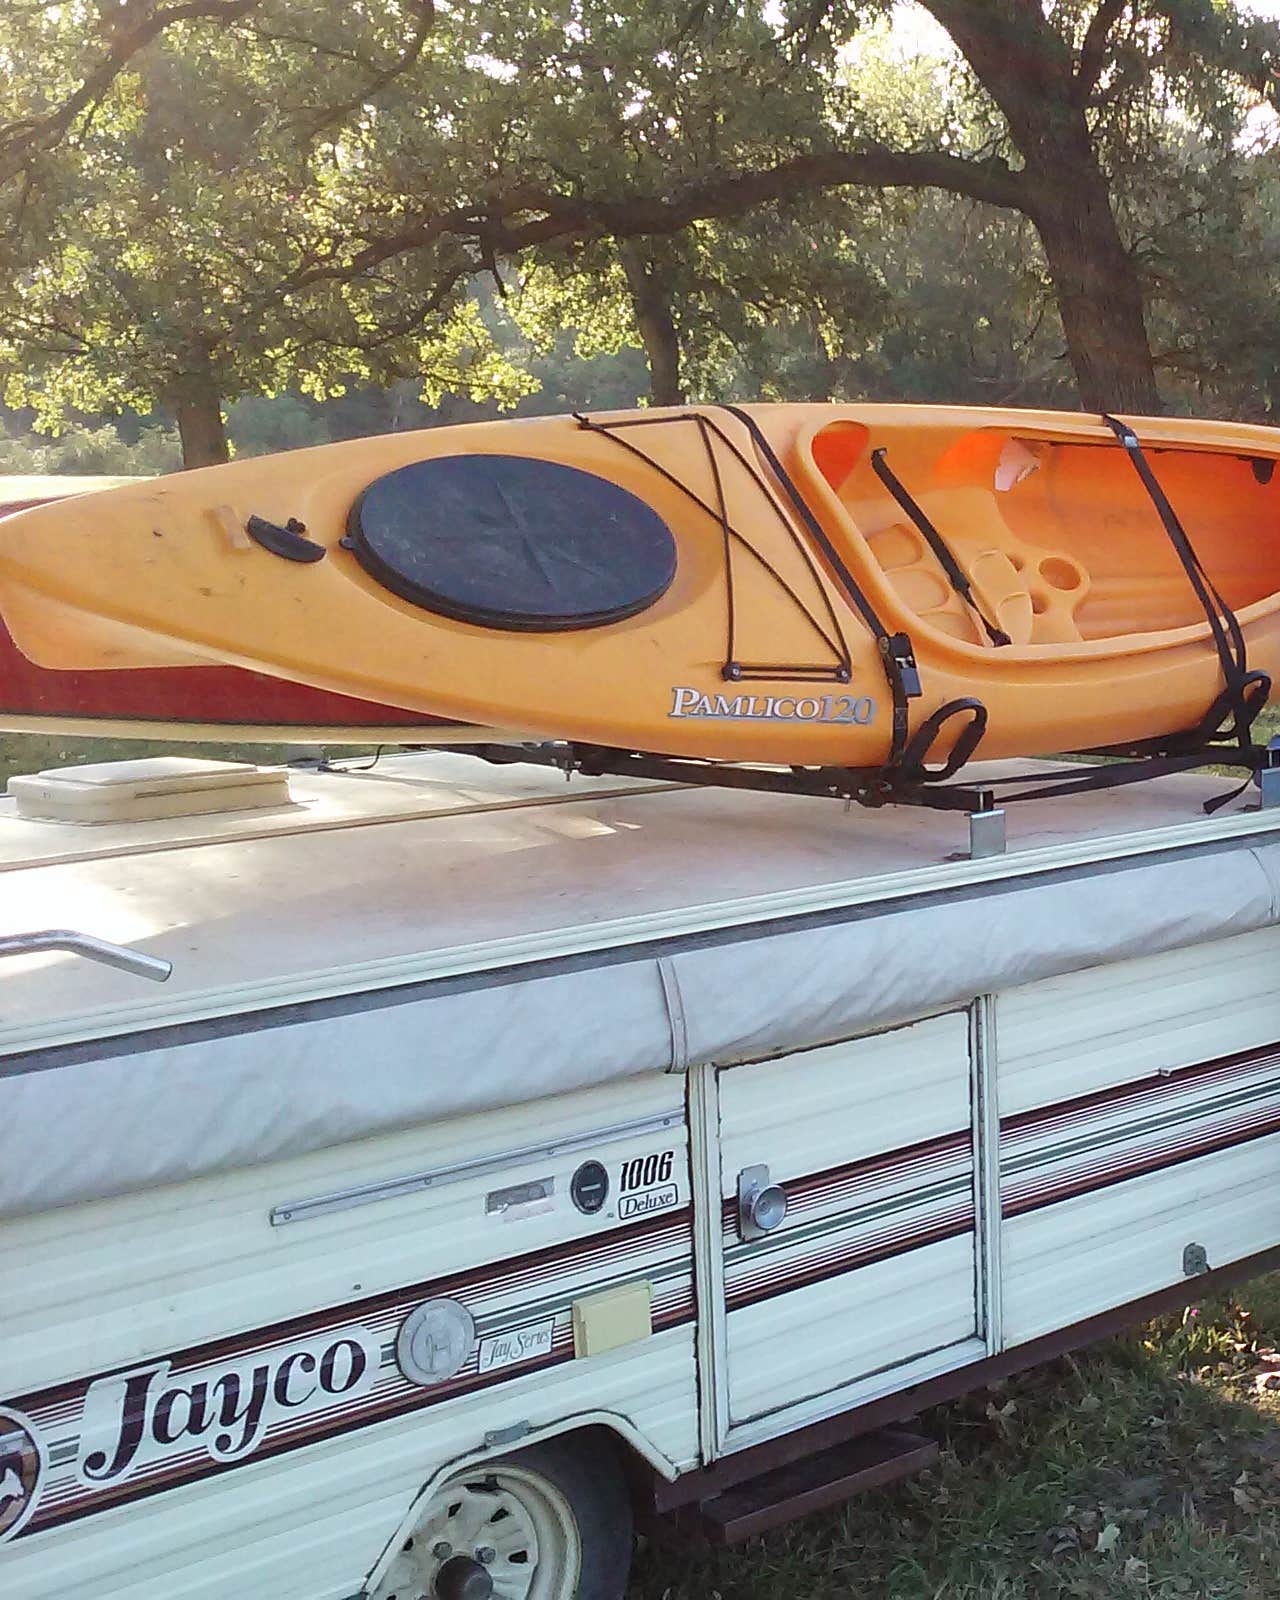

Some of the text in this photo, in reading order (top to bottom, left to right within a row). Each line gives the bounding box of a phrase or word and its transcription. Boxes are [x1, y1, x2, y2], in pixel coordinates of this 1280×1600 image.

[620, 1150, 674, 1192] 1006
[624, 1191, 674, 1216] Deluxe
[483, 1330, 549, 1367] Jay Series
[83, 1337, 368, 1482] Jayco
